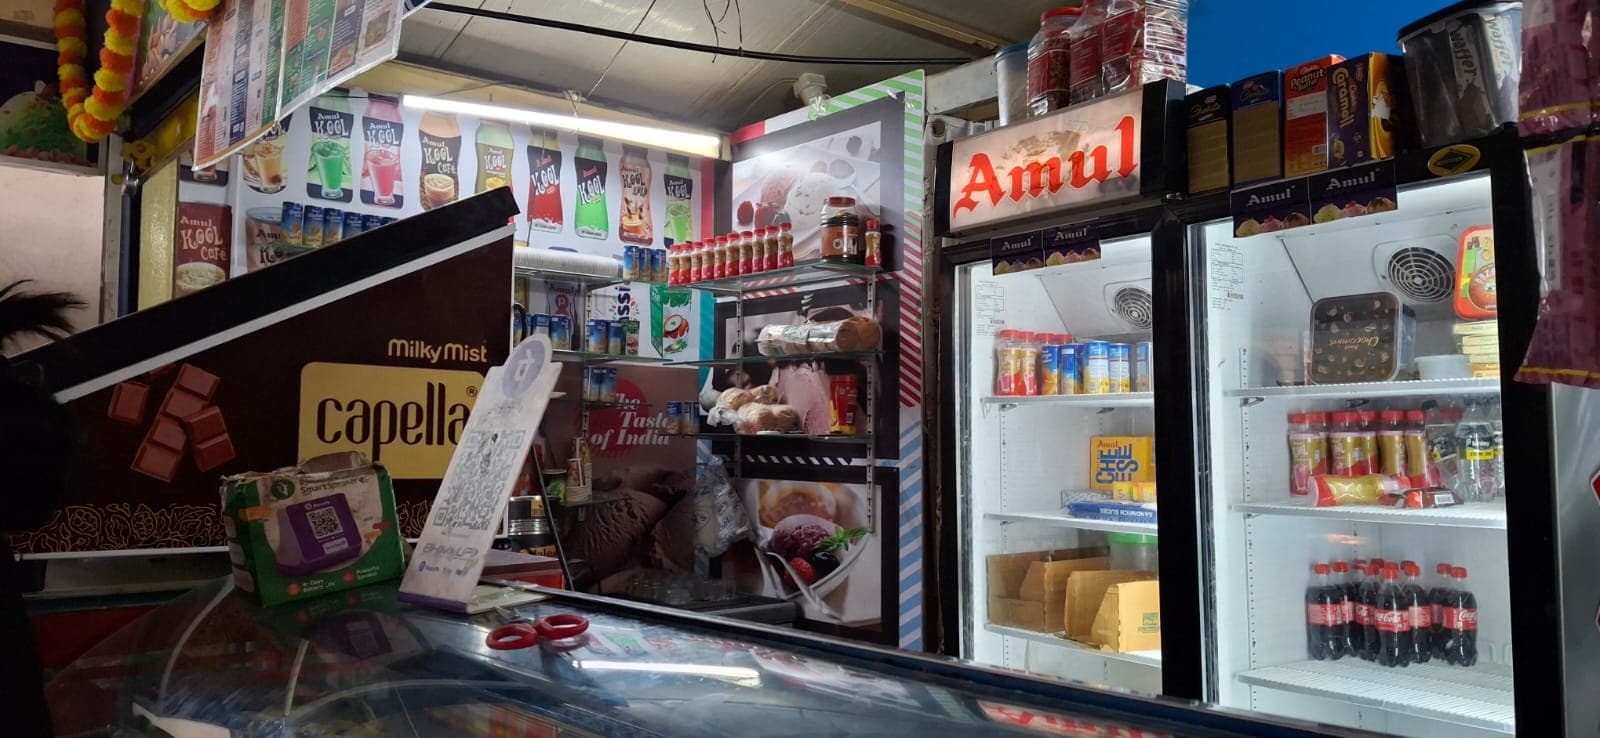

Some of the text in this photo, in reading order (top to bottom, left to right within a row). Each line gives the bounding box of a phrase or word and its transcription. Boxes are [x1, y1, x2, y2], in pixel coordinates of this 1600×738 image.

[1290, 68, 1324, 90] Peanut
[1332, 67, 1355, 128] Caramell
[317, 113, 340, 121] Amul
[369, 122, 391, 130] Amul
[314, 118, 349, 139] KOOL
[366, 127, 400, 147] KOOL
[422, 137, 445, 147] Amul
[423, 144, 454, 165] KOOL
[483, 154, 507, 170] KOOL
[952, 115, 1139, 219] Amul
[531, 164, 560, 196] KOOL
[577, 175, 606, 206] KOOL
[622, 172, 646, 189] KOOL
[1325, 171, 1376, 192] Amul
[667, 184, 690, 198] KOOL
[1247, 188, 1292, 207] Amul
[180, 216, 212, 227] Amul
[180, 226, 224, 250] KOOL
[1000, 239, 1032, 251] Amul
[1054, 227, 1088, 242] Amul
[388, 338, 488, 364] Milky Mist
[316, 381, 471, 463] capella
[590, 429, 670, 451] of India
